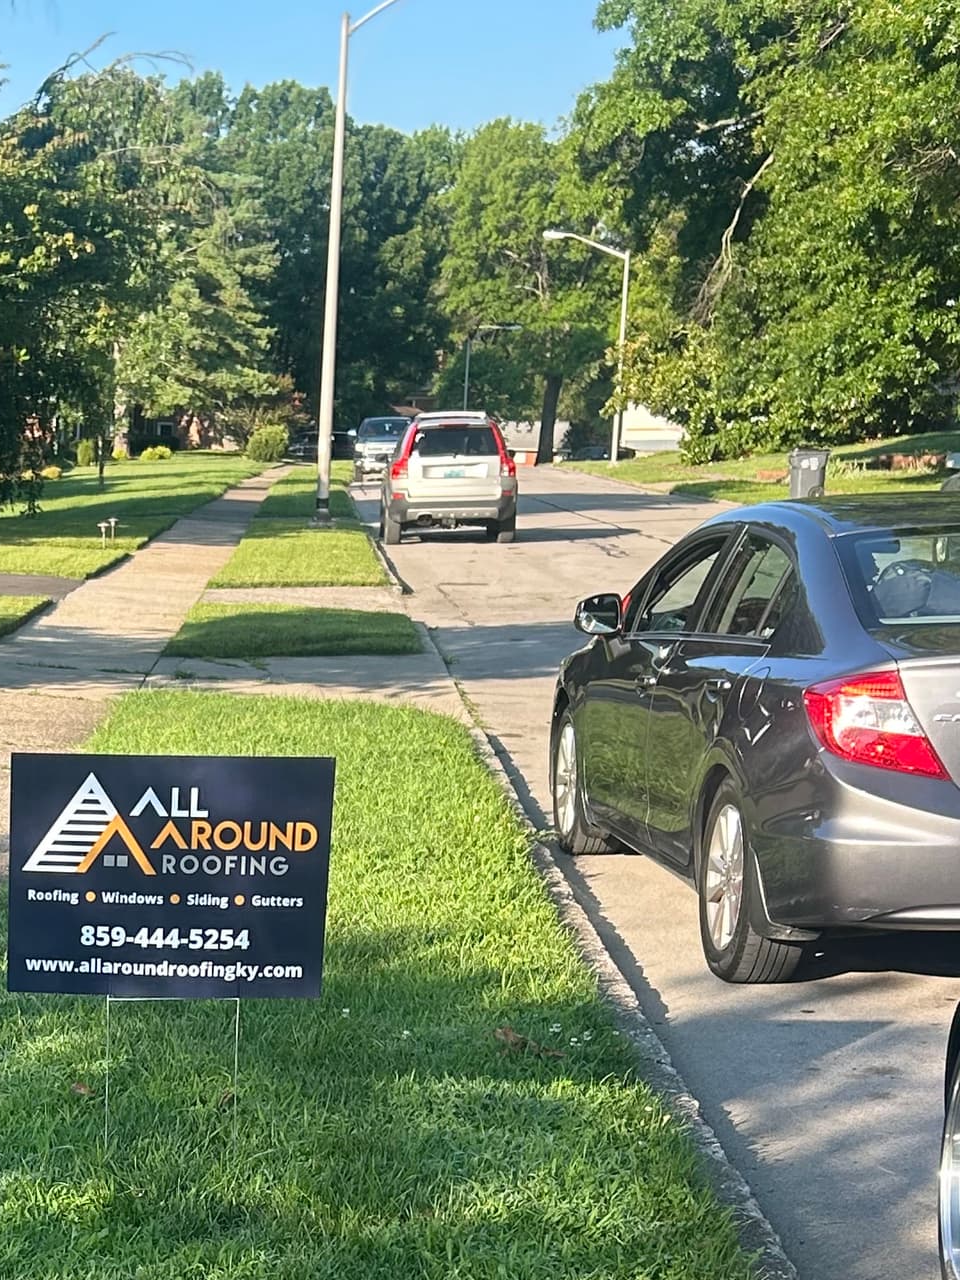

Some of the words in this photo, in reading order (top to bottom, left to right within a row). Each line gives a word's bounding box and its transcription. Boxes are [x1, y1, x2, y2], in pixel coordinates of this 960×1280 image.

[129, 787, 209, 817] ALL
[150, 820, 318, 851] AROUND
[162, 855, 289, 876] ROOFING
[28, 889, 79, 905] Roofing
[102, 892, 164, 905] Windows
[187, 894, 229, 909] Siding
[251, 895, 304, 907] Gutters
[80, 926, 250, 950] 859-444-5254
[25, 958, 303, 980] www.allaroundroofingky.com
